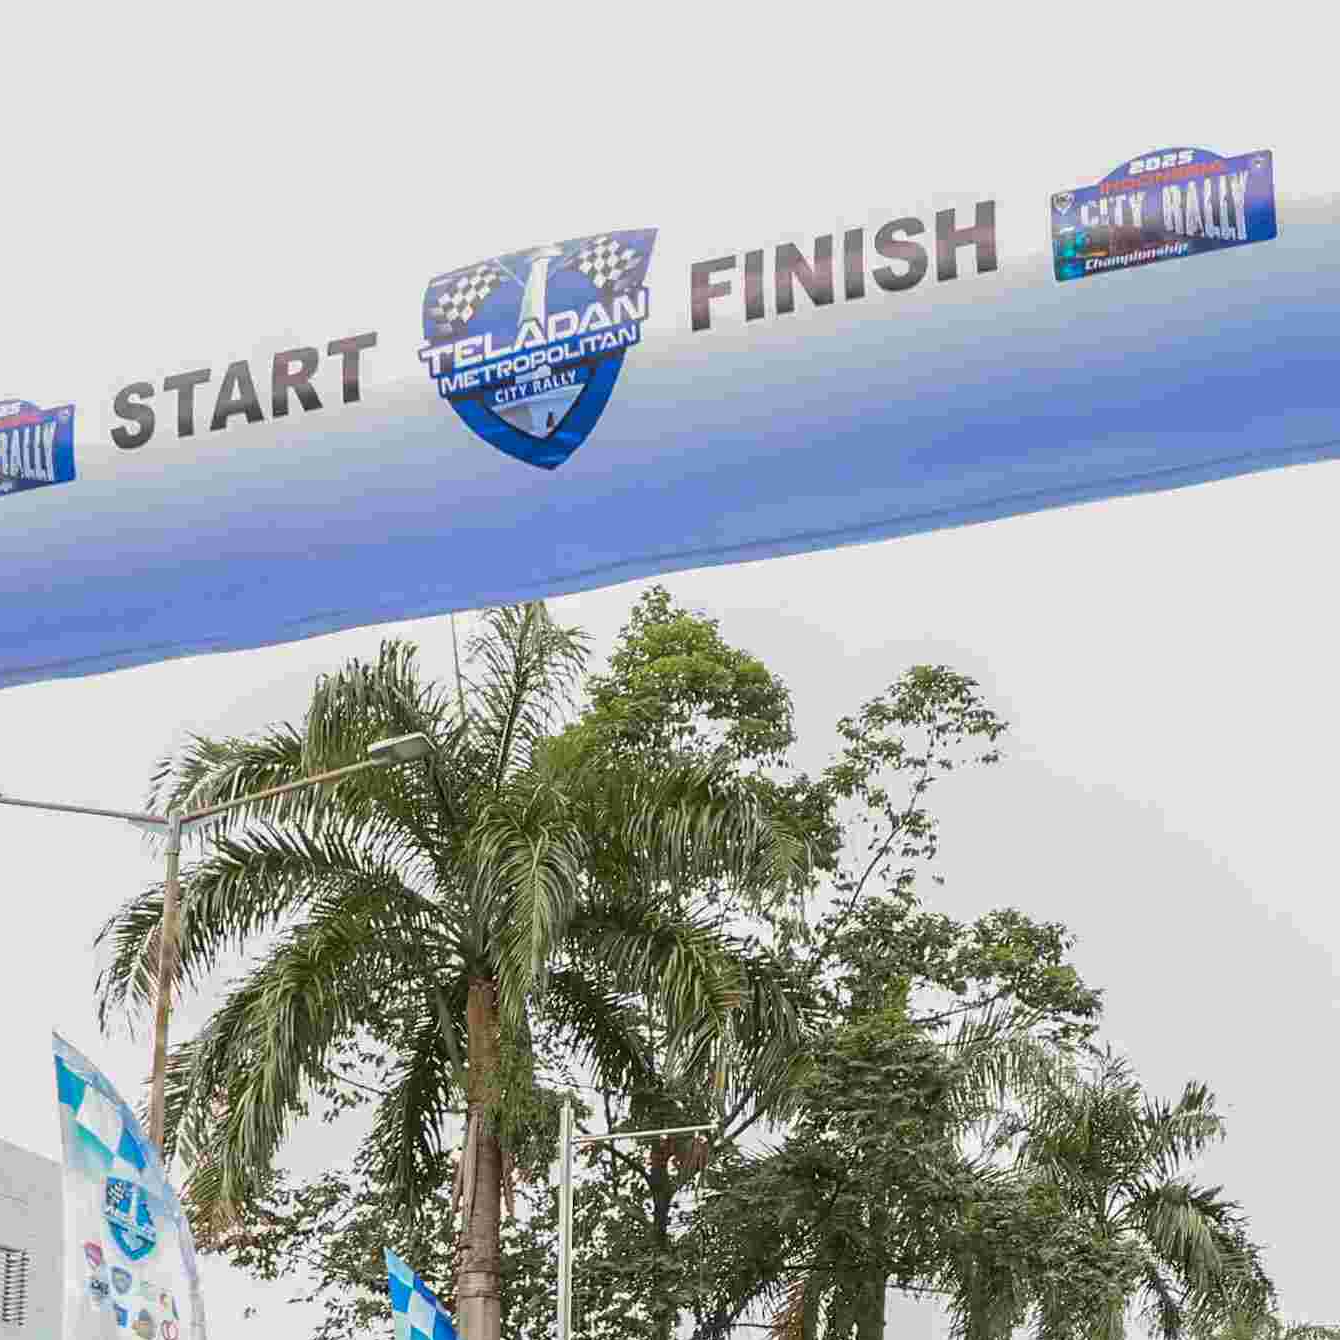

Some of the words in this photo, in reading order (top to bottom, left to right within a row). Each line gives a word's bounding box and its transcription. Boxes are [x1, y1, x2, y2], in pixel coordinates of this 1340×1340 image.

[1129, 150, 1194, 174] 2025
[1080, 192, 1144, 225] CITY
[1163, 170, 1249, 239] RALLY
[690, 200, 998, 331] FINISH
[419, 290, 651, 376] TELADAN
[440, 325, 638, 395] METROPOLITAN
[109, 332, 378, 450] START
[495, 382, 529, 403] CITY
[533, 370, 577, 392] RALLY
